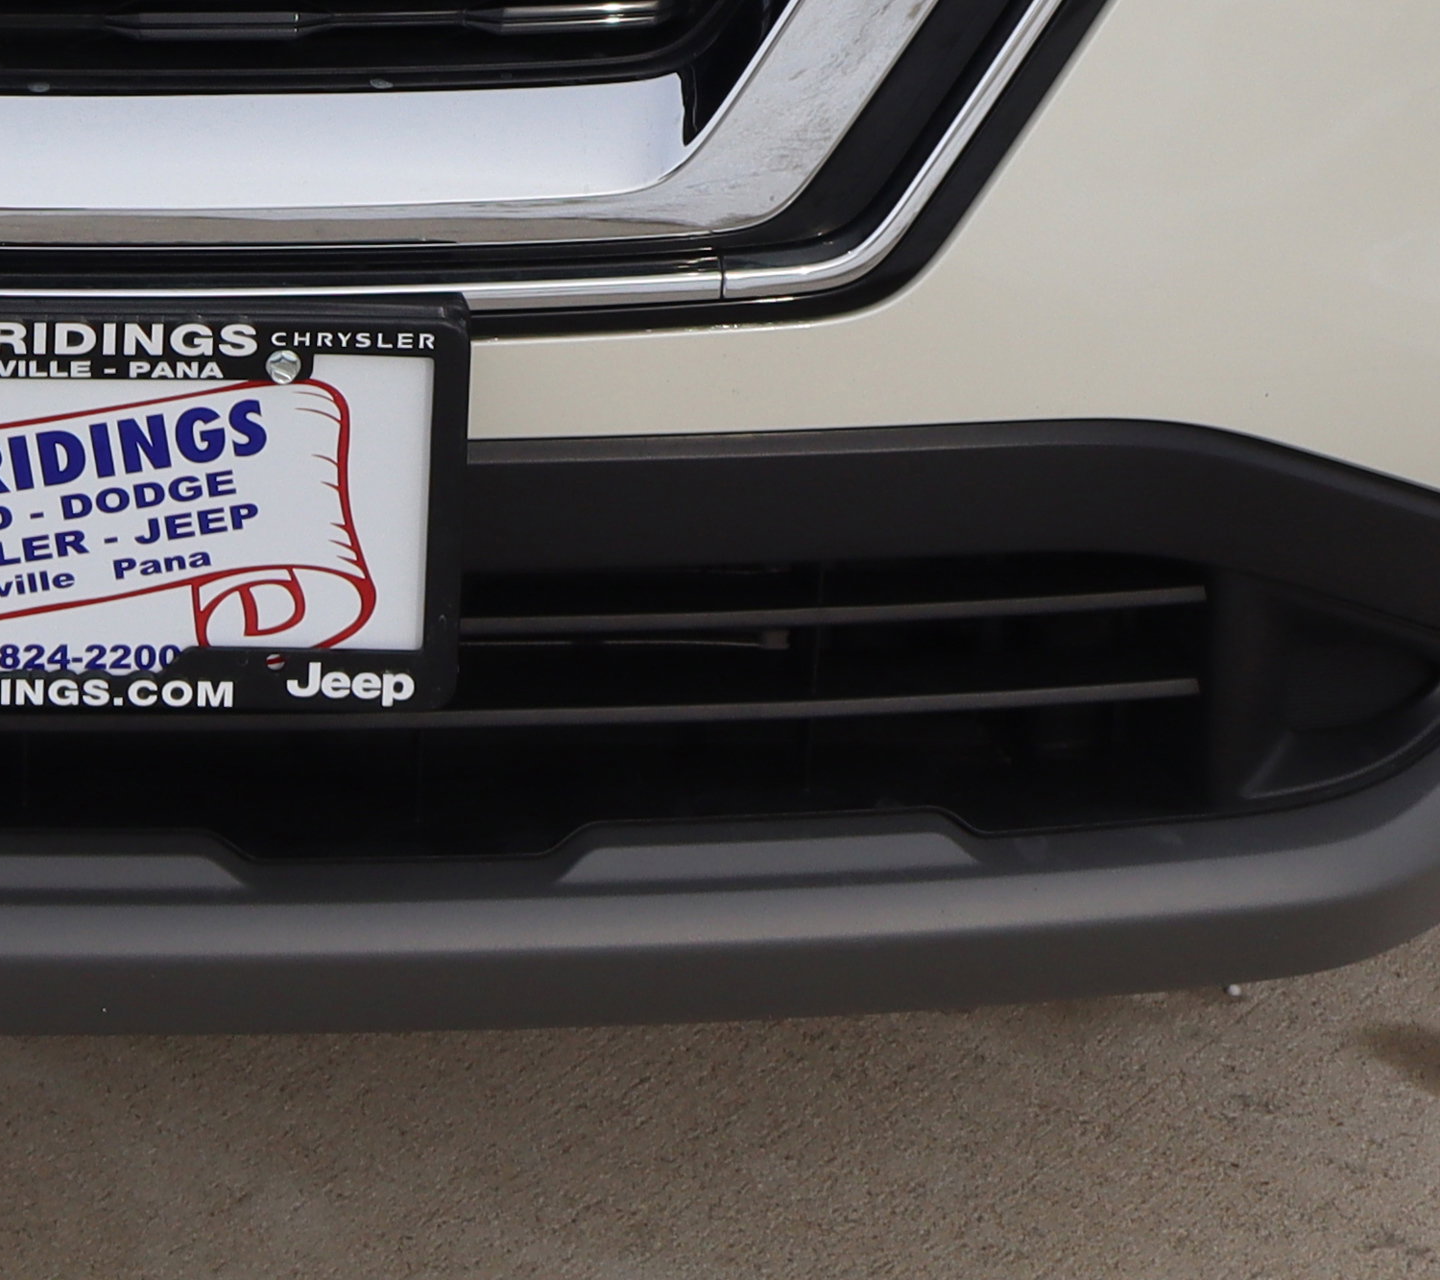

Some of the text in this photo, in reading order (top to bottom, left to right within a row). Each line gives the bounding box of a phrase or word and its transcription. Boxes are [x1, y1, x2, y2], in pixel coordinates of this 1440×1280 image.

[270, 331, 436, 350] CHRYSLER
[128, 360, 224, 379] PANA
[60, 469, 237, 520] DODGE
[133, 503, 260, 545] JEEP
[113, 551, 212, 580] Pana
[286, 661, 416, 707] Jeep
